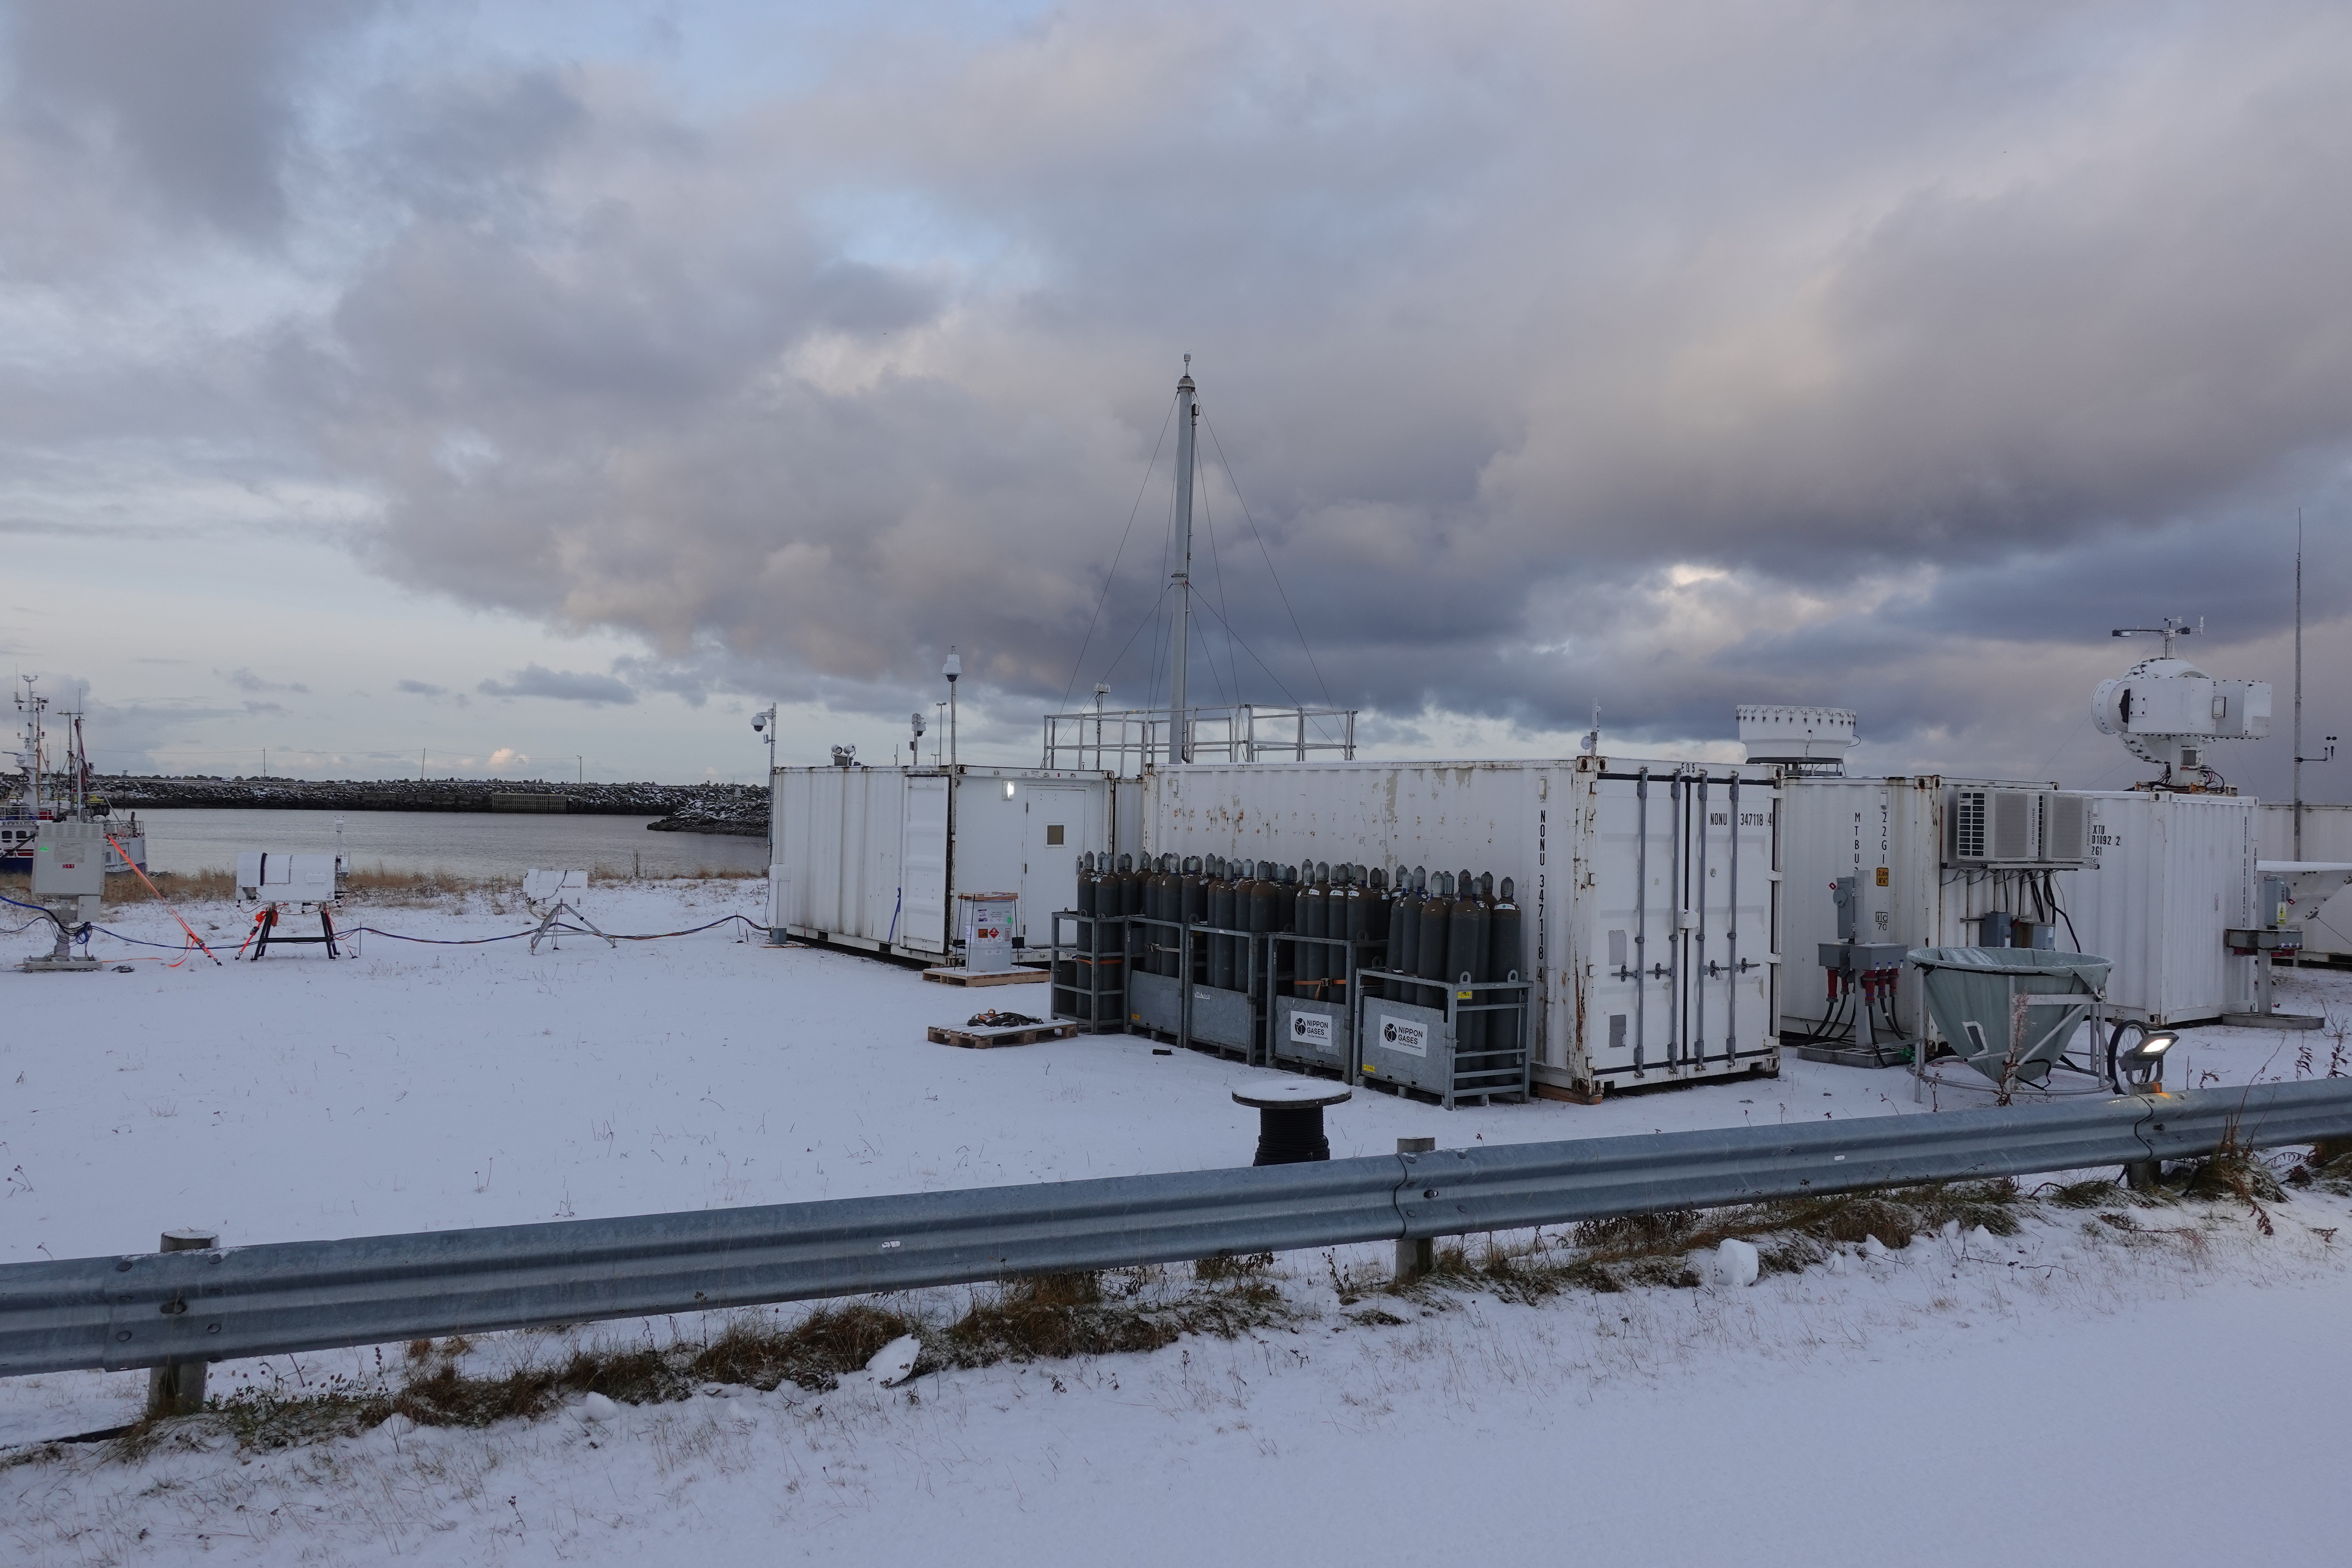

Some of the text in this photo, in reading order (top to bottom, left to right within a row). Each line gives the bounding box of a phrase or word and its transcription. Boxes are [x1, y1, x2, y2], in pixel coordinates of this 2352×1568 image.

[1710, 813, 1772, 826] NONU 347118 4
[2092, 824, 2105, 835] XTU
[2092, 835, 2120, 845] 01092 2
[2092, 846, 2102, 856] 2G1
[1307, 1020, 1328, 1029] NIPPON
[1307, 1027, 1324, 1035] GASES
[1398, 1026, 1423, 1038] NIPPON
[1398, 1034, 1418, 1044] GASES
